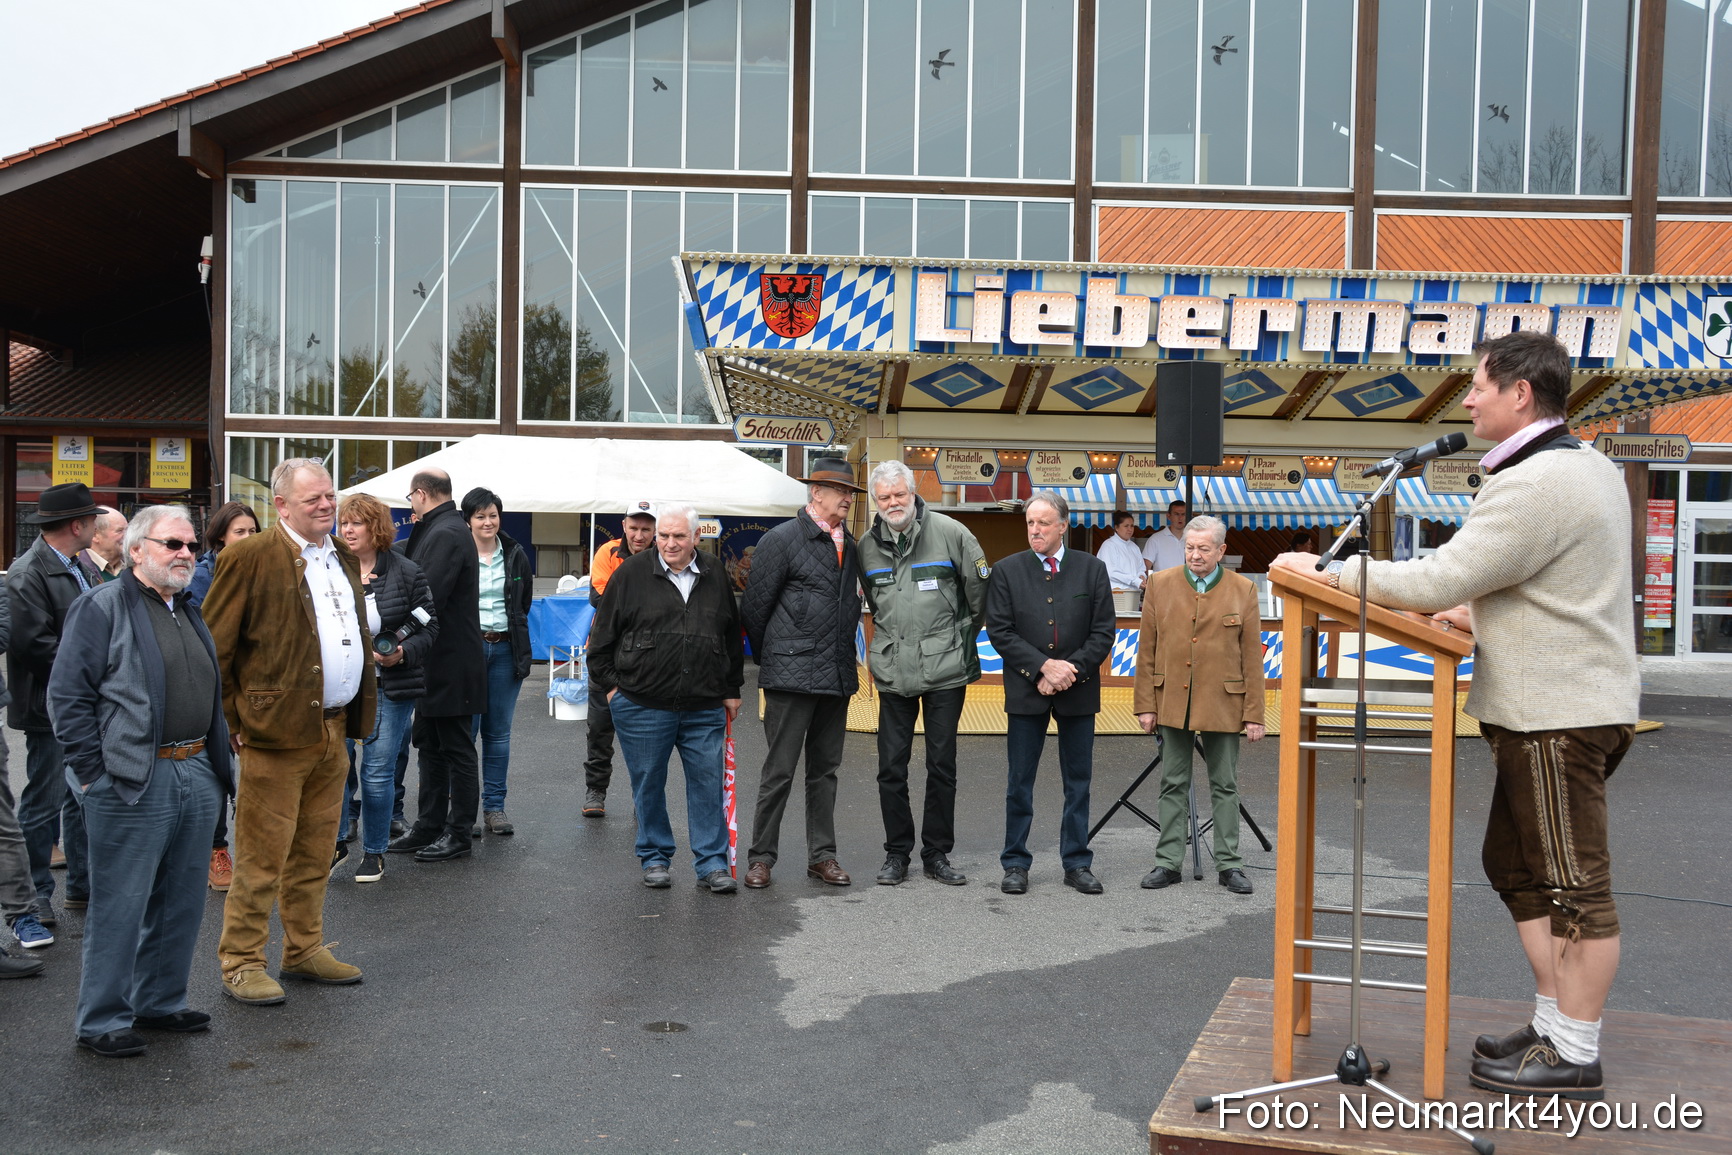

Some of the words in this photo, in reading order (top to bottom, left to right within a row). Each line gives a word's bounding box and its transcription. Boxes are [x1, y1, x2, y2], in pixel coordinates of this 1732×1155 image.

[914, 272, 1623, 358] Liebermann
[742, 418, 825, 442] Schaschlik
[946, 450, 983, 463] Frikadelle
[1037, 451, 1062, 464] Steak
[1257, 457, 1276, 468] Paar
[1432, 461, 1480, 474] Fischbrötchen
[700, 523, 717, 534] abe
